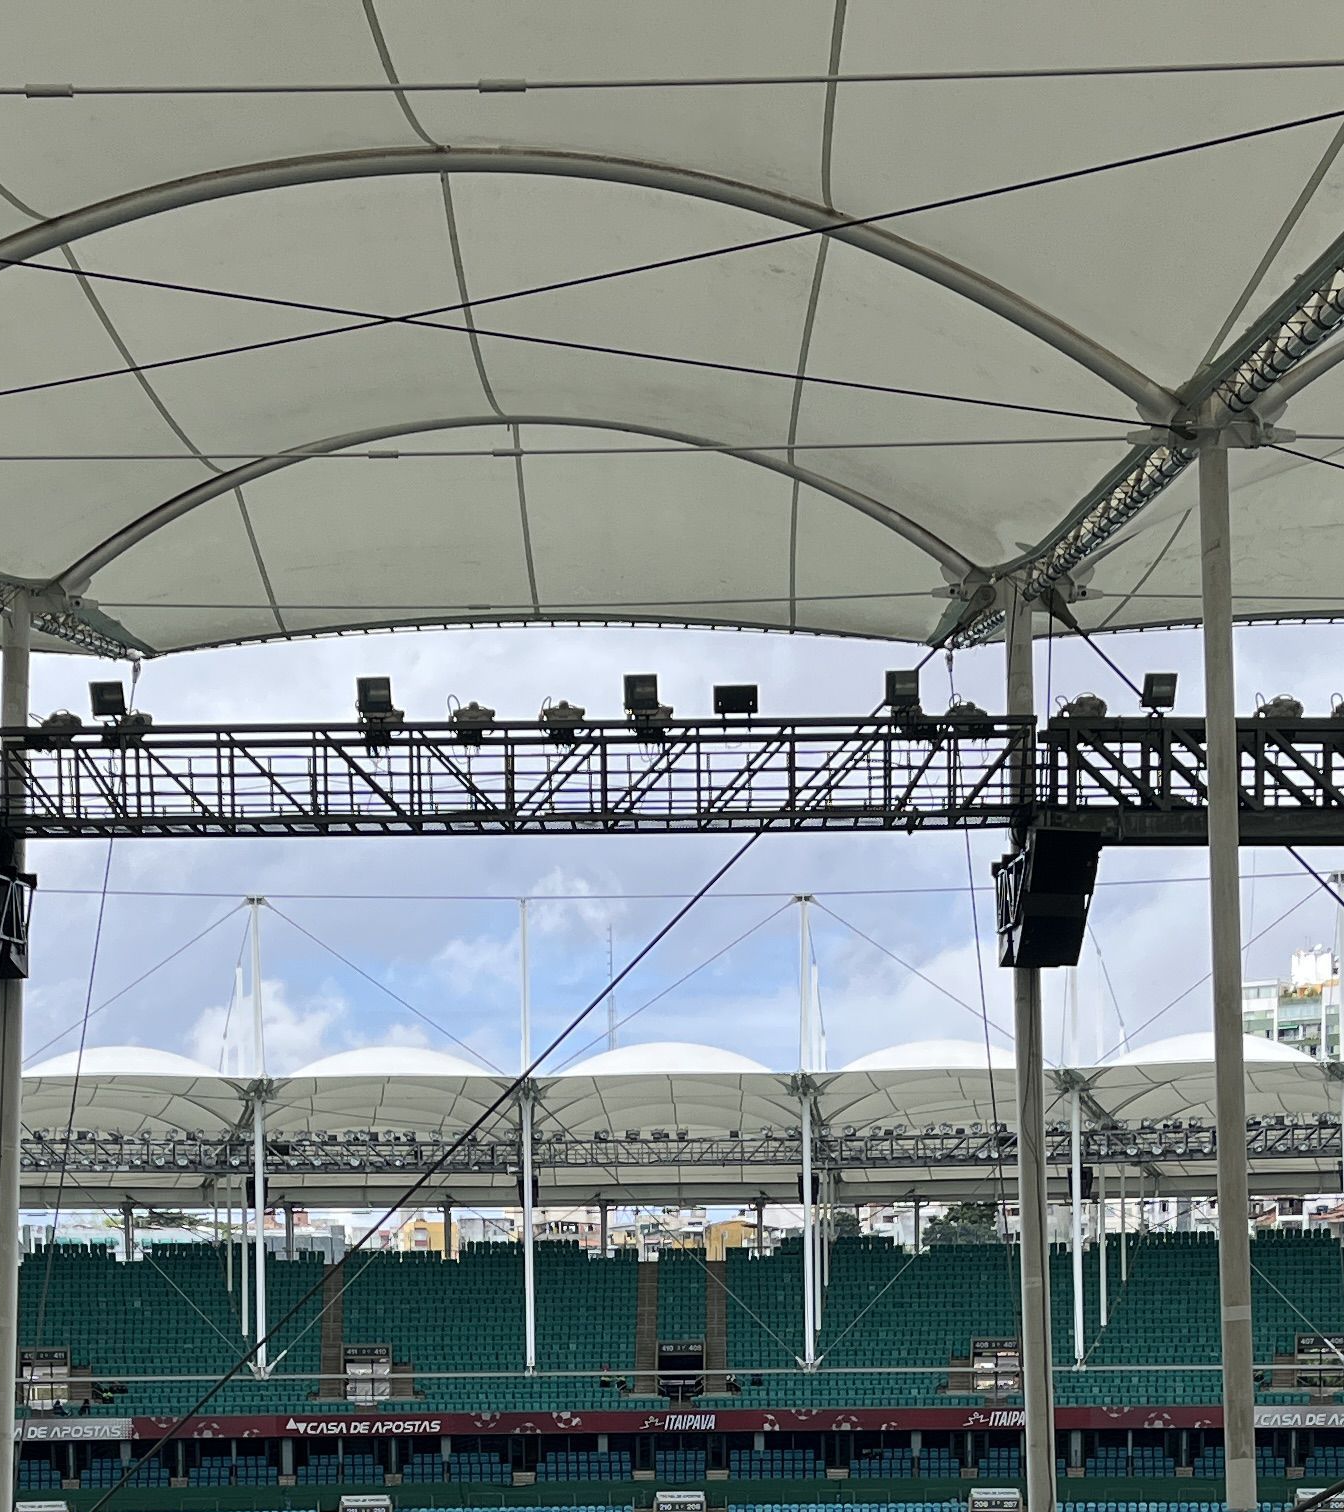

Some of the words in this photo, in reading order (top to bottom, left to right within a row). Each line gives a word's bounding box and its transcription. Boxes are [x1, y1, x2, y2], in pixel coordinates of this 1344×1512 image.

[307, 1420, 347, 1434] CASA
[351, 1420, 369, 1433] DE
[372, 1419, 442, 1433] APOSTAS
[664, 1414, 716, 1431] ITAIPAVA
[988, 1411, 1025, 1427] ITAIPA
[1261, 1413, 1302, 1427] CASA
[1305, 1413, 1327, 1426] DE
[27, 1426, 47, 1438] DE
[50, 1425, 123, 1438] APOSTAS
